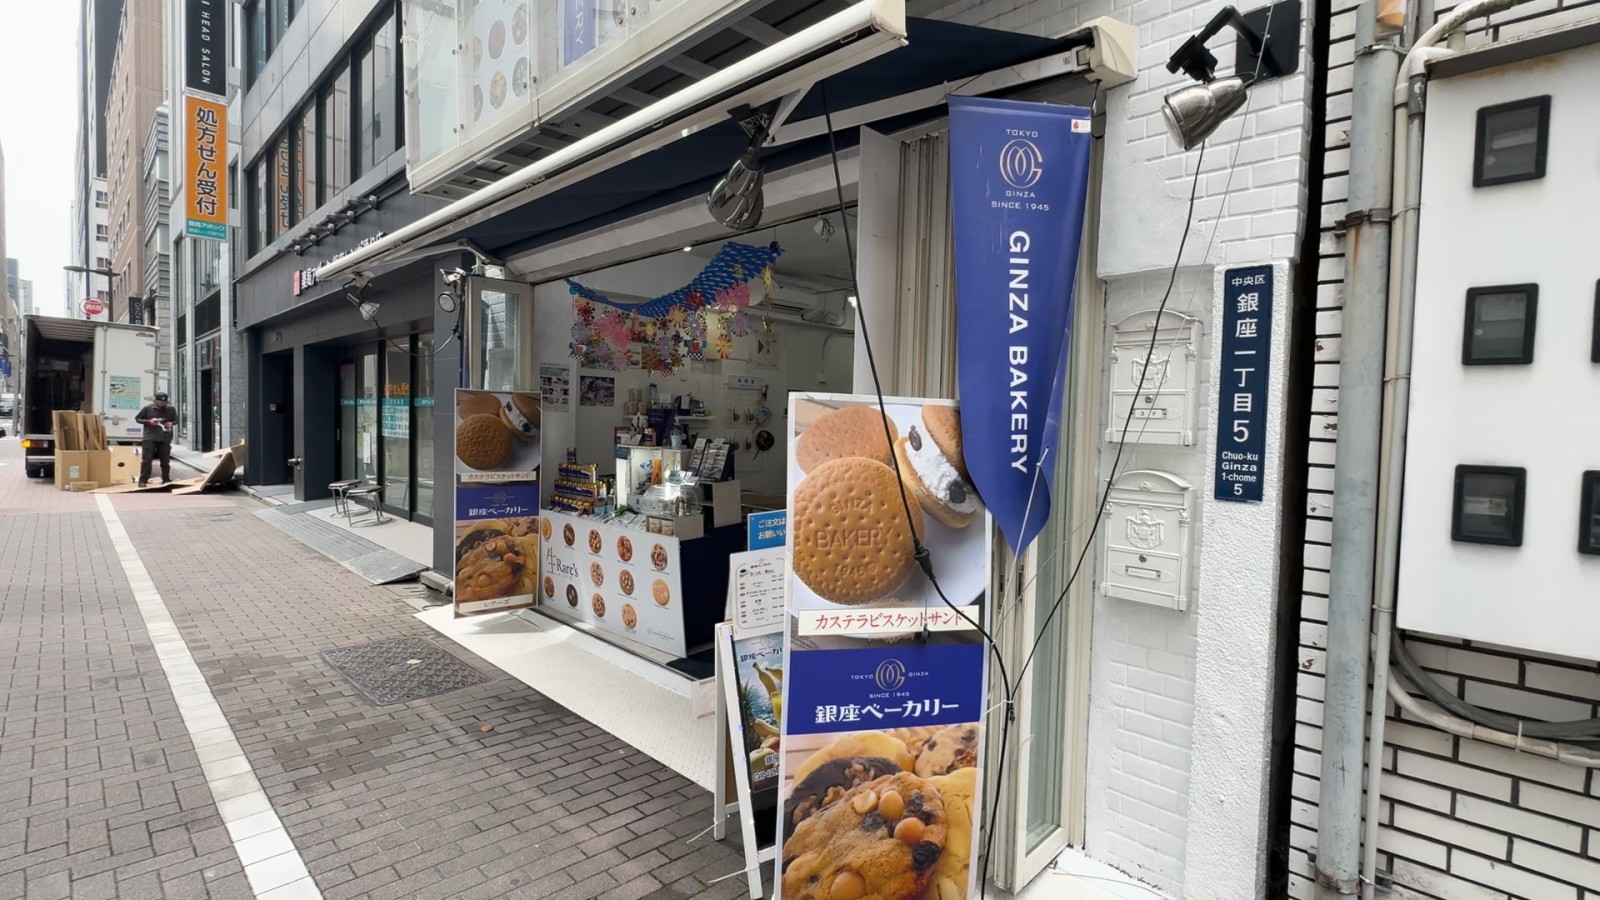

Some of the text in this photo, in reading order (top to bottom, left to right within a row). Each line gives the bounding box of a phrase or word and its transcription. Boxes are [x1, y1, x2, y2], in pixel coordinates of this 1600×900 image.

[201, 11, 211, 41] HEAD
[201, 48, 211, 84] SALON
[1005, 128, 1039, 138] TOKYO
[196, 106, 218, 216] 処方せん受付
[1005, 190, 1036, 199] GINZA
[991, 201, 1050, 212] SINCE 1945
[1231, 274, 1266, 287] 中央区
[1008, 230, 1031, 474] GINZA BAKERY
[1221, 451, 1258, 461] Chuo-ku
[1221, 462, 1257, 472] Ginza
[1221, 472, 1257, 482] 1-chome
[1233, 483, 1243, 495] 5
[468, 506, 529, 517] 銀座ベーカリー
[556, 557, 579, 578] Rare's
[815, 610, 965, 630] カステラビスケットサンド
[815, 698, 960, 724] 銀座ベーカリー
